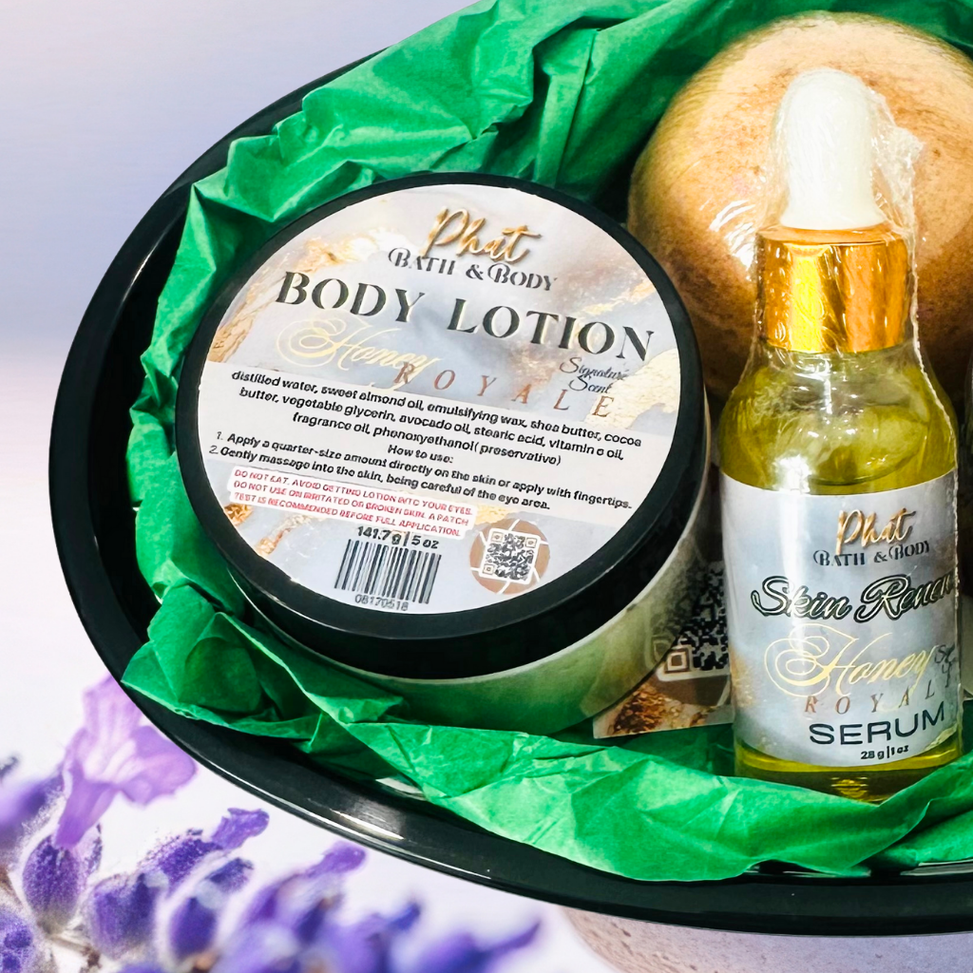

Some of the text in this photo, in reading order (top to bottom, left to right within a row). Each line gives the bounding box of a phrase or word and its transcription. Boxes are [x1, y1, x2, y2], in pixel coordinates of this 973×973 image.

[419, 206, 542, 263] Phat
[388, 247, 557, 291] BATH & BODY
[275, 271, 654, 362] BODY LOTION
[276, 310, 443, 391] Honey
[394, 362, 615, 418] ROYALE
[836, 507, 916, 555] Phat
[813, 549, 865, 567] BATH
[874, 551, 887, 564] &
[750, 575, 852, 621] Skin
[764, 623, 940, 713] Honey
[804, 679, 935, 716] ROYAL
[808, 700, 945, 746] SERUM
